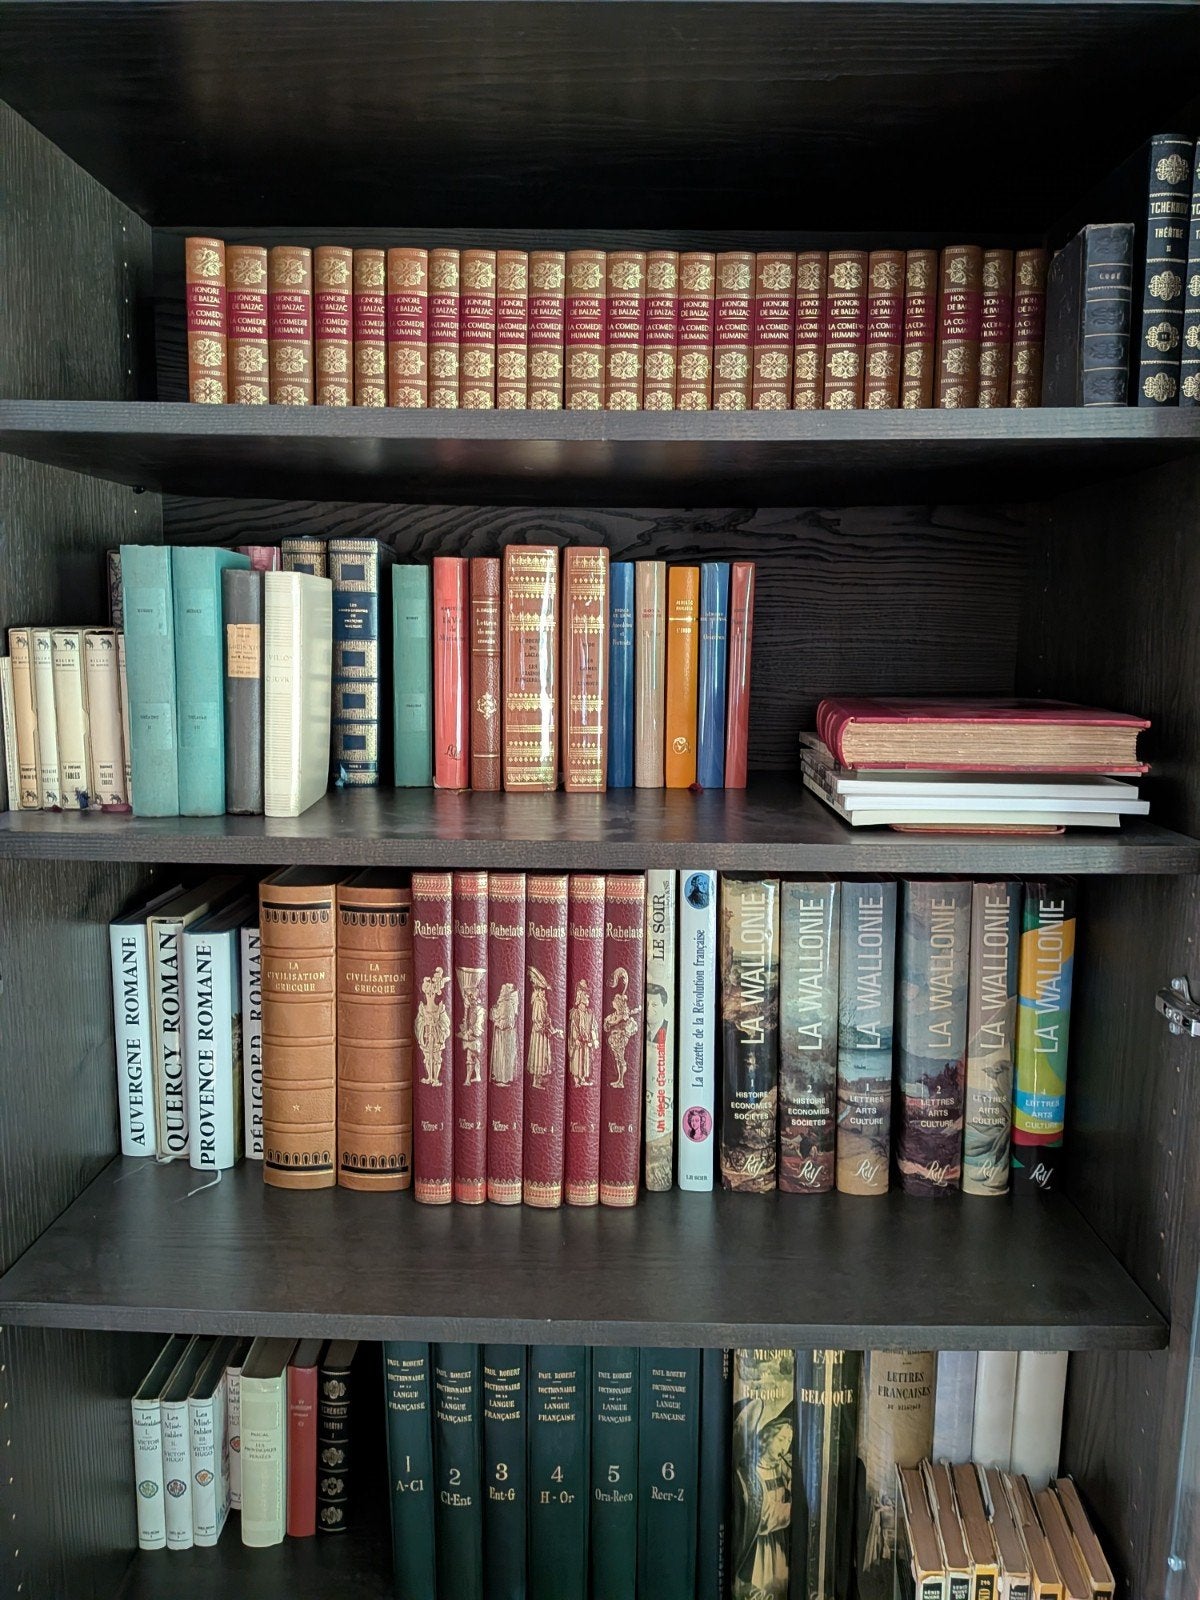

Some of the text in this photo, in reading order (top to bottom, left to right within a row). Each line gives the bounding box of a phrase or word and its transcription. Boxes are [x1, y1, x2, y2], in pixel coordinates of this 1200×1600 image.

[532, 331, 560, 339] HUMAINE
[414, 920, 451, 939] Rabelais
[455, 920, 487, 938] Rabelais
[490, 921, 524, 940] Rabelais
[528, 921, 566, 941] Rabelais
[570, 921, 601, 940] Rabelais
[606, 922, 643, 941] Rabelais
[653, 894, 665, 961] LE SOIR
[267, 971, 325, 980] CIVILISATION
[741, 893, 765, 1044] LA WALLONIE
[798, 899, 824, 1050] LA WALLONIE
[857, 897, 883, 1048] LA WALLONIE
[928, 898, 955, 1048] LA WALLONIE
[980, 895, 1011, 1048] LA WALLONIE
[1033, 900, 1065, 1053] LA WALLONIE
[346, 973, 406, 982] CIVILISATION
[275, 983, 316, 992] GRECQUE
[354, 984, 396, 994] GRECQUE
[692, 930, 707, 1087] La Gazette de la Révolution française
[122, 937, 145, 1146] AUVERGNE ROMANE
[159, 933, 189, 1151] QUERCY ROMAN
[196, 944, 215, 1165] PROVENCE ROMANE
[807, 1084, 812, 1093] 2
[866, 1083, 870, 1092] 1
[937, 1086, 941, 1094] 2
[973, 1094, 1007, 1102] LETTRES
[628, 1124, 632, 1132] 6
[850, 1117, 883, 1125] CULTURE
[920, 1120, 954, 1128] CULTURE
[972, 1117, 1005, 1125] CULTURE
[887, 1372, 925, 1383] LETTRES
[389, 1402, 425, 1411] FRANÇAISE
[485, 1410, 520, 1421] FRANÇAISE
[406, 1456, 410, 1472] 1
[496, 1463, 508, 1480] 3
[662, 1462, 675, 1480] 6
[449, 1468, 460, 1485] 2
[551, 1466, 563, 1482] 4
[608, 1465, 620, 1482] 5
[540, 1491, 550, 1503] H
[560, 1491, 575, 1503] Or
